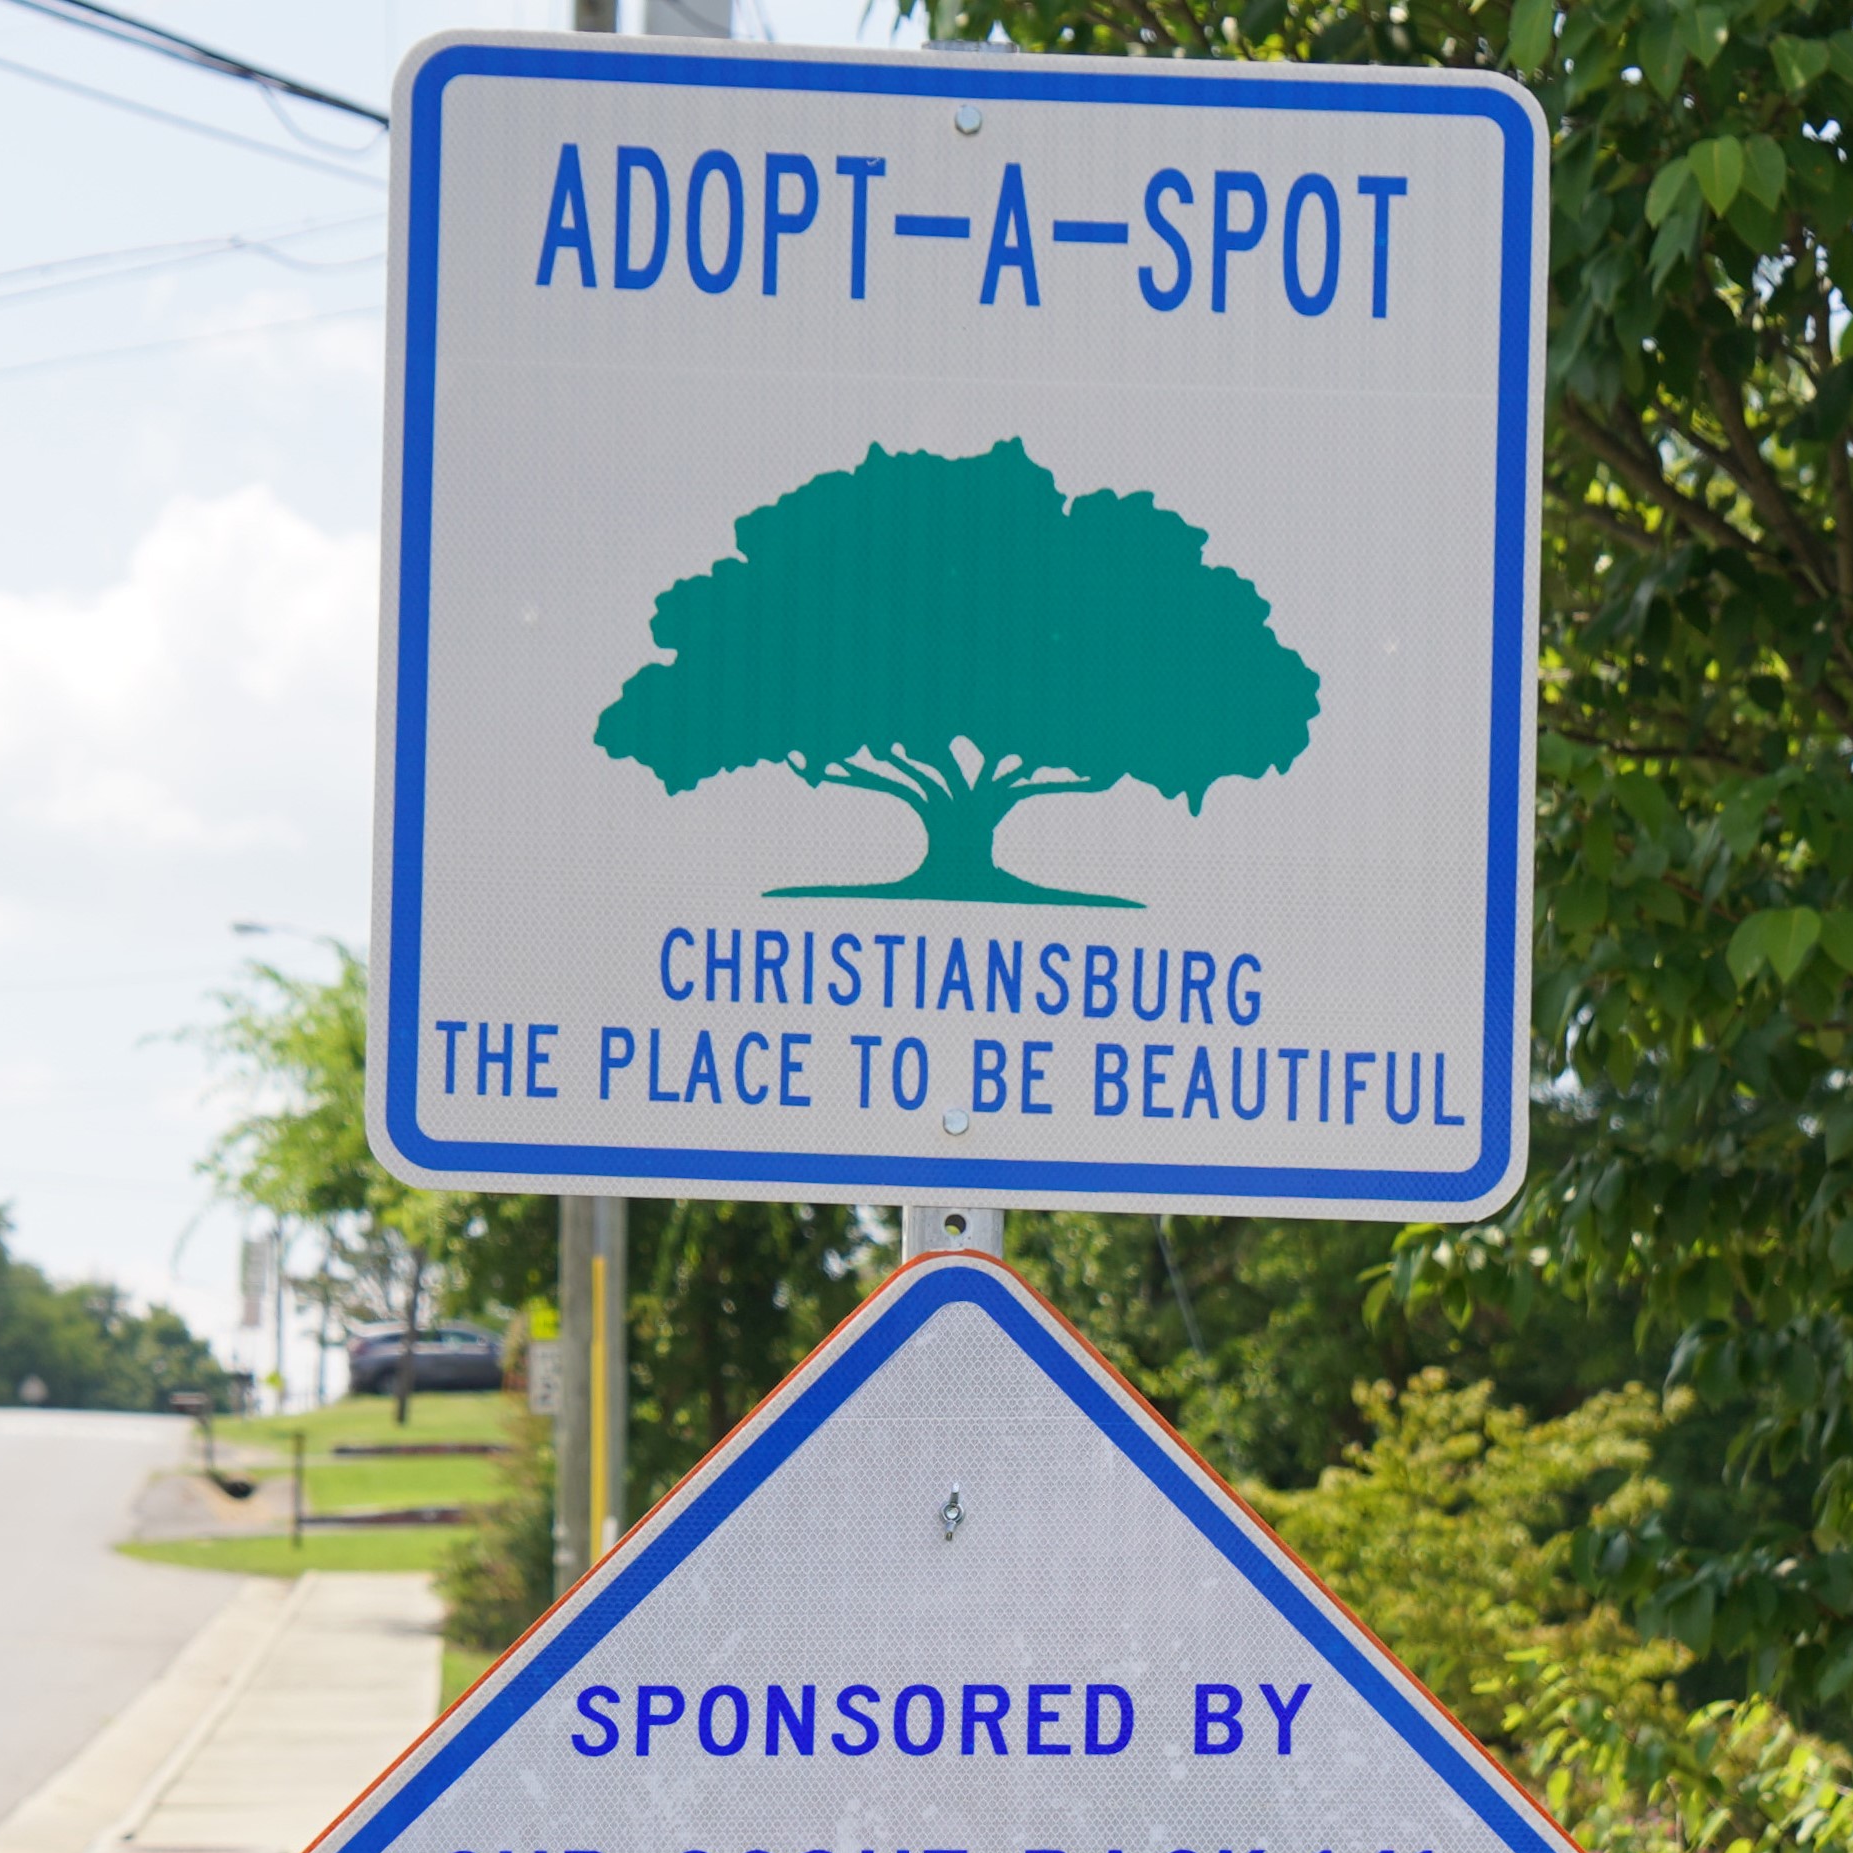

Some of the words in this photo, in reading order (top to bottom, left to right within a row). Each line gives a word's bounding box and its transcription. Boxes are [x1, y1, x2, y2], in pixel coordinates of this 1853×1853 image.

[535, 143, 1408, 319] ADOPT-A-SPOT
[660, 927, 1262, 1027] CHRISTIANSBURG
[435, 1020, 559, 1099] THE
[599, 1026, 812, 1107] PLACE
[850, 1034, 929, 1111] TO
[972, 1039, 1054, 1115] BE
[1094, 1043, 1466, 1126] BEAUTIFUL
[571, 1683, 1135, 1758] SPONSORED
[1193, 1683, 1313, 1756] BY
